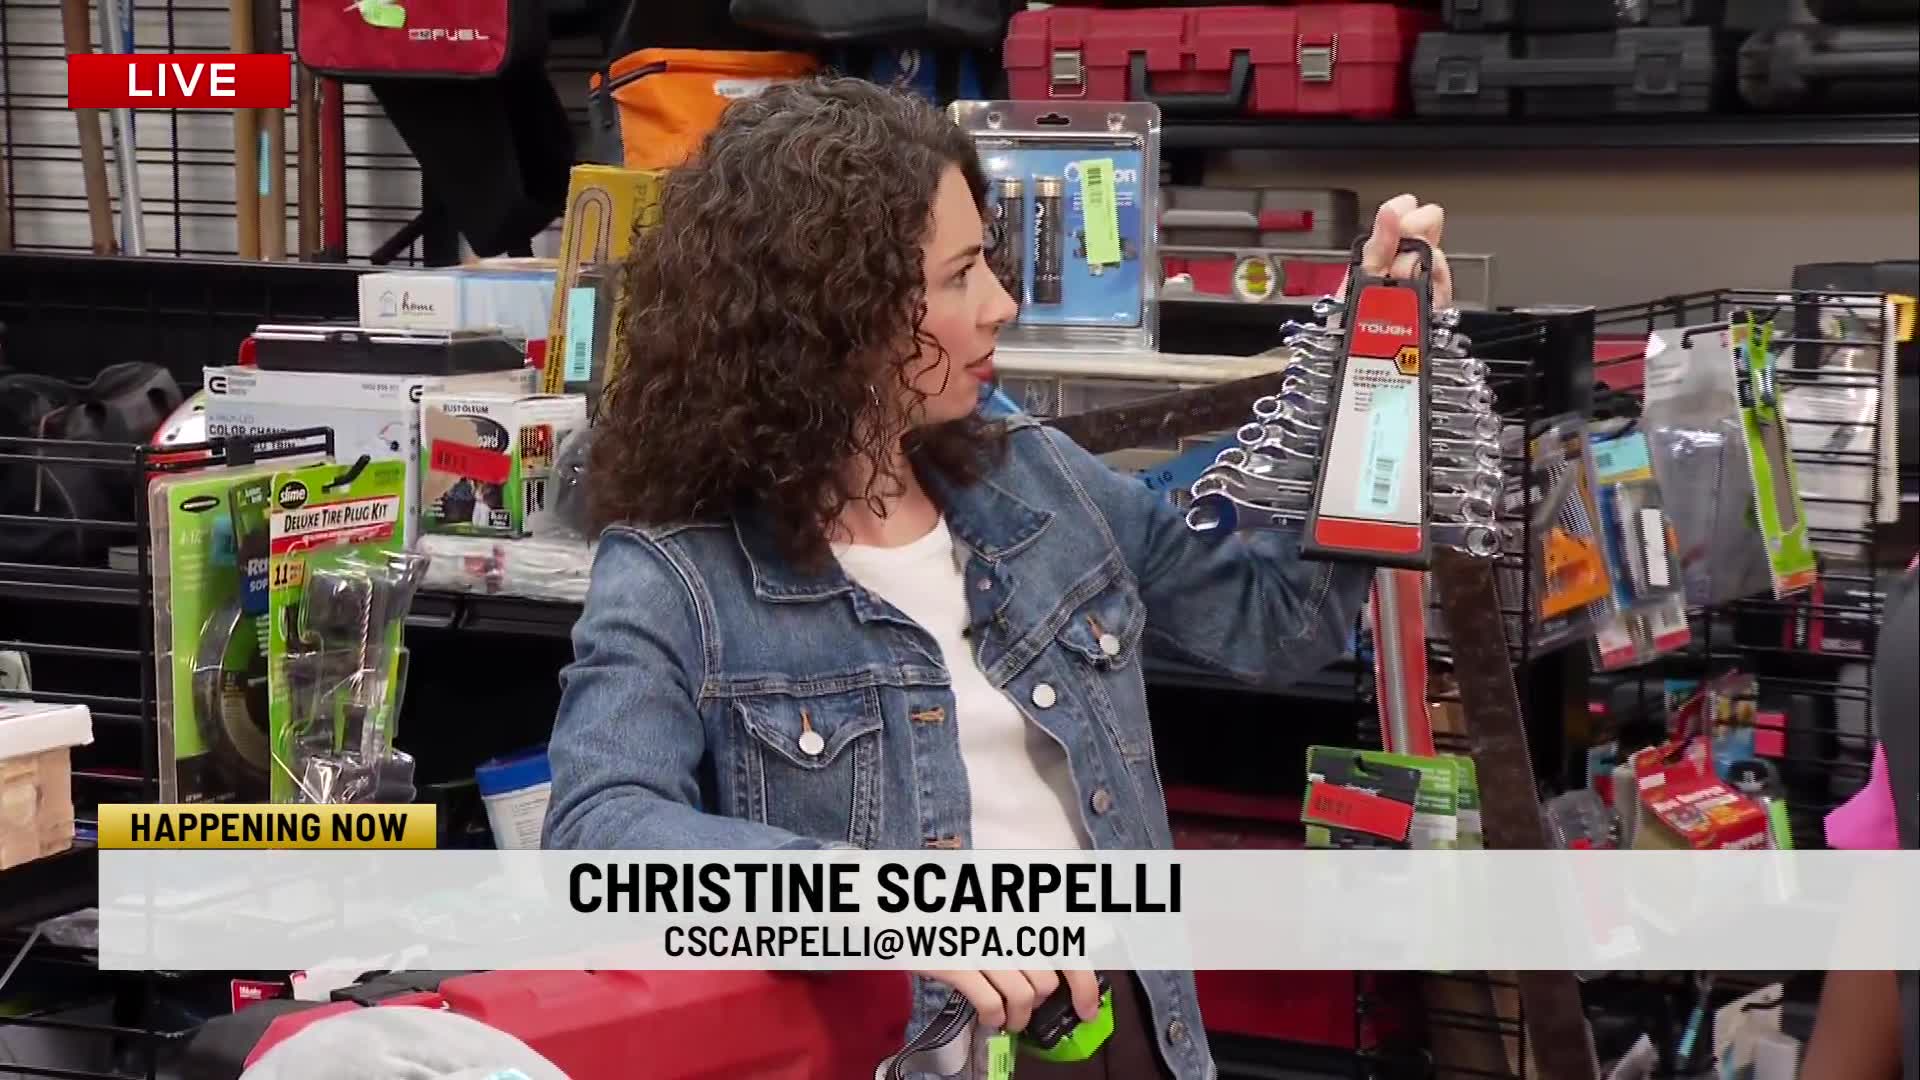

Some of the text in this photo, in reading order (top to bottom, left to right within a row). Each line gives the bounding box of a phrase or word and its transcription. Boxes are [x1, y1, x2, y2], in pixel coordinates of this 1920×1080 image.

[431, 28, 490, 41] FUEL
[401, 290, 435, 312] home
[1358, 322, 1414, 337] TOUGH
[208, 424, 247, 437] COLOR
[279, 485, 307, 503] slime
[283, 501, 389, 533] DELUXE TIRE PLUG KIT
[273, 562, 288, 587] 11
